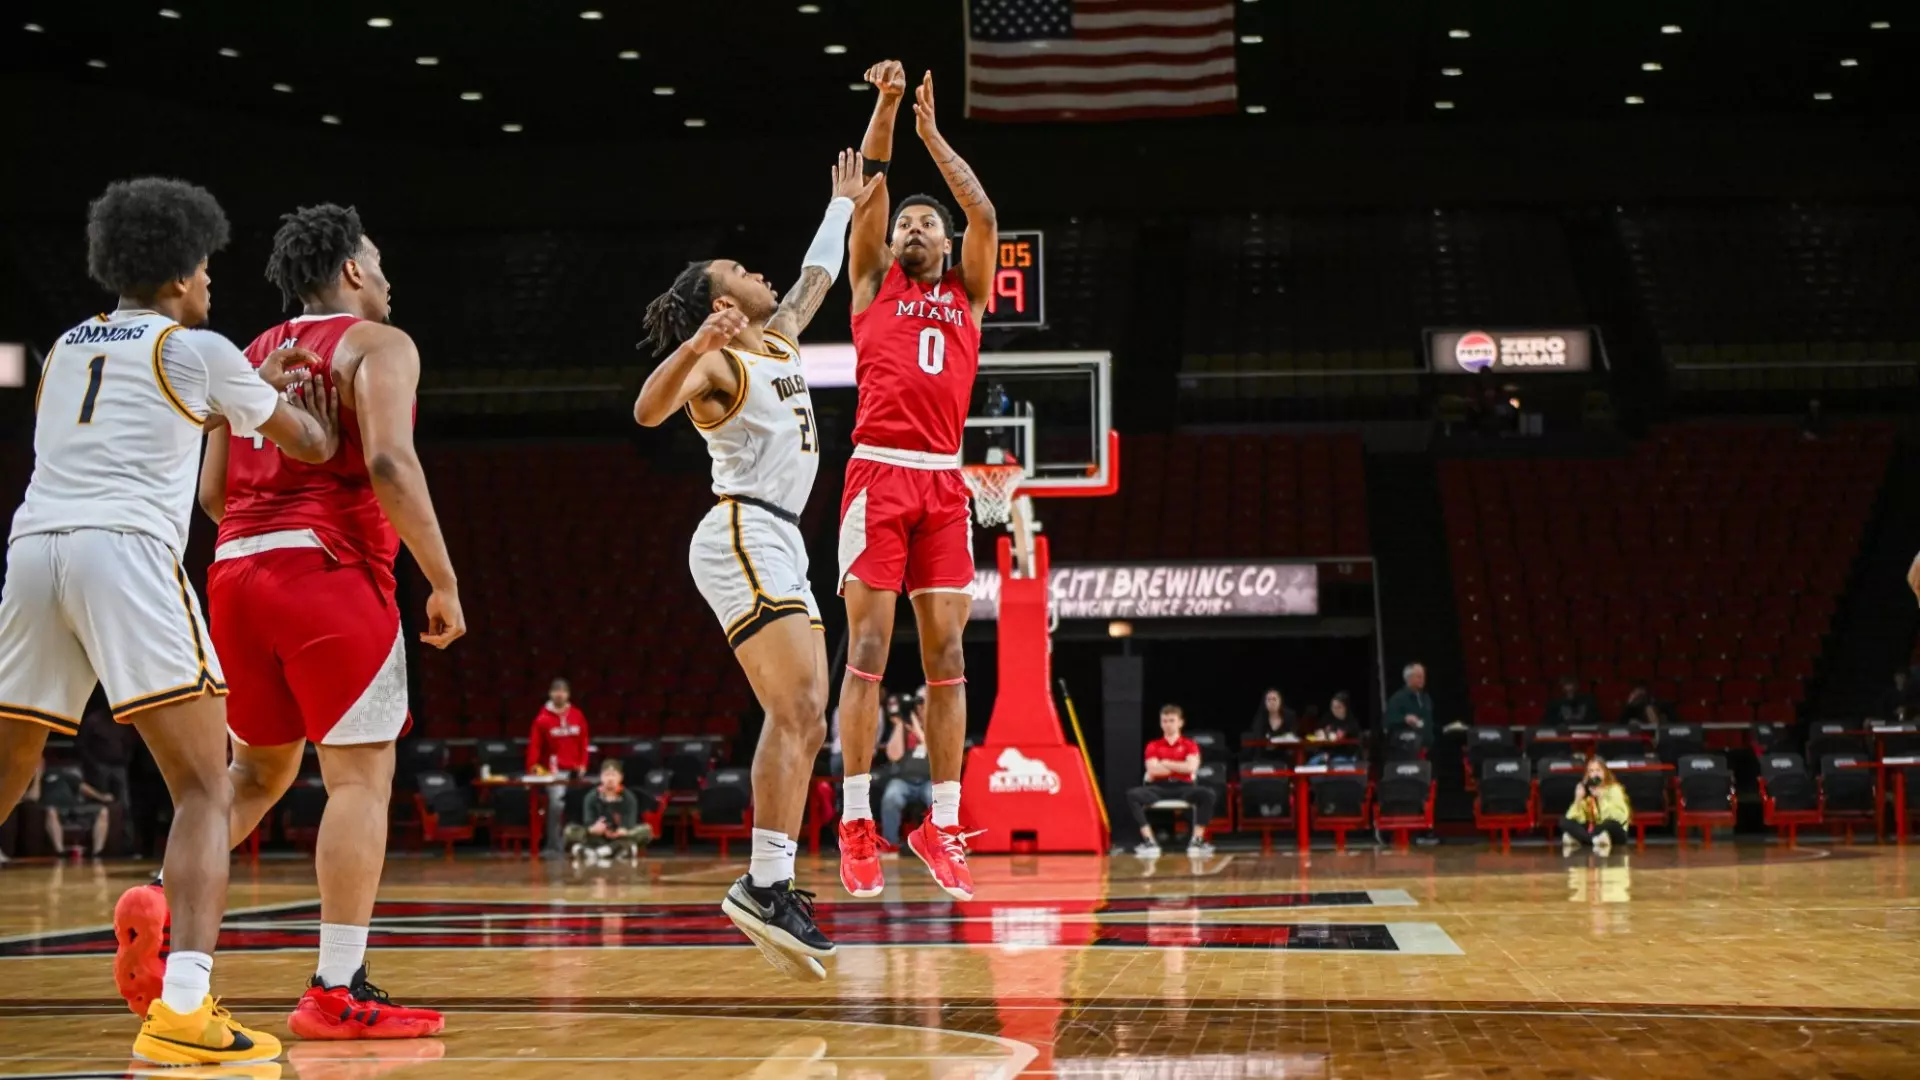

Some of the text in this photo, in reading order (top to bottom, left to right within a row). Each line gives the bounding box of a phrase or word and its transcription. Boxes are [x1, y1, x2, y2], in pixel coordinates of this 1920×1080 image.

[896, 300, 963, 327] MIAMI
[65, 324, 149, 345] SIMMONS
[1500, 336, 1566, 353] ZERO
[917, 326, 945, 376] 0
[1501, 353, 1566, 366] SUGAR
[77, 354, 106, 425] 1
[1052, 566, 1280, 600] CITY BREWING CO.
[1135, 599, 1181, 617] SINCE
